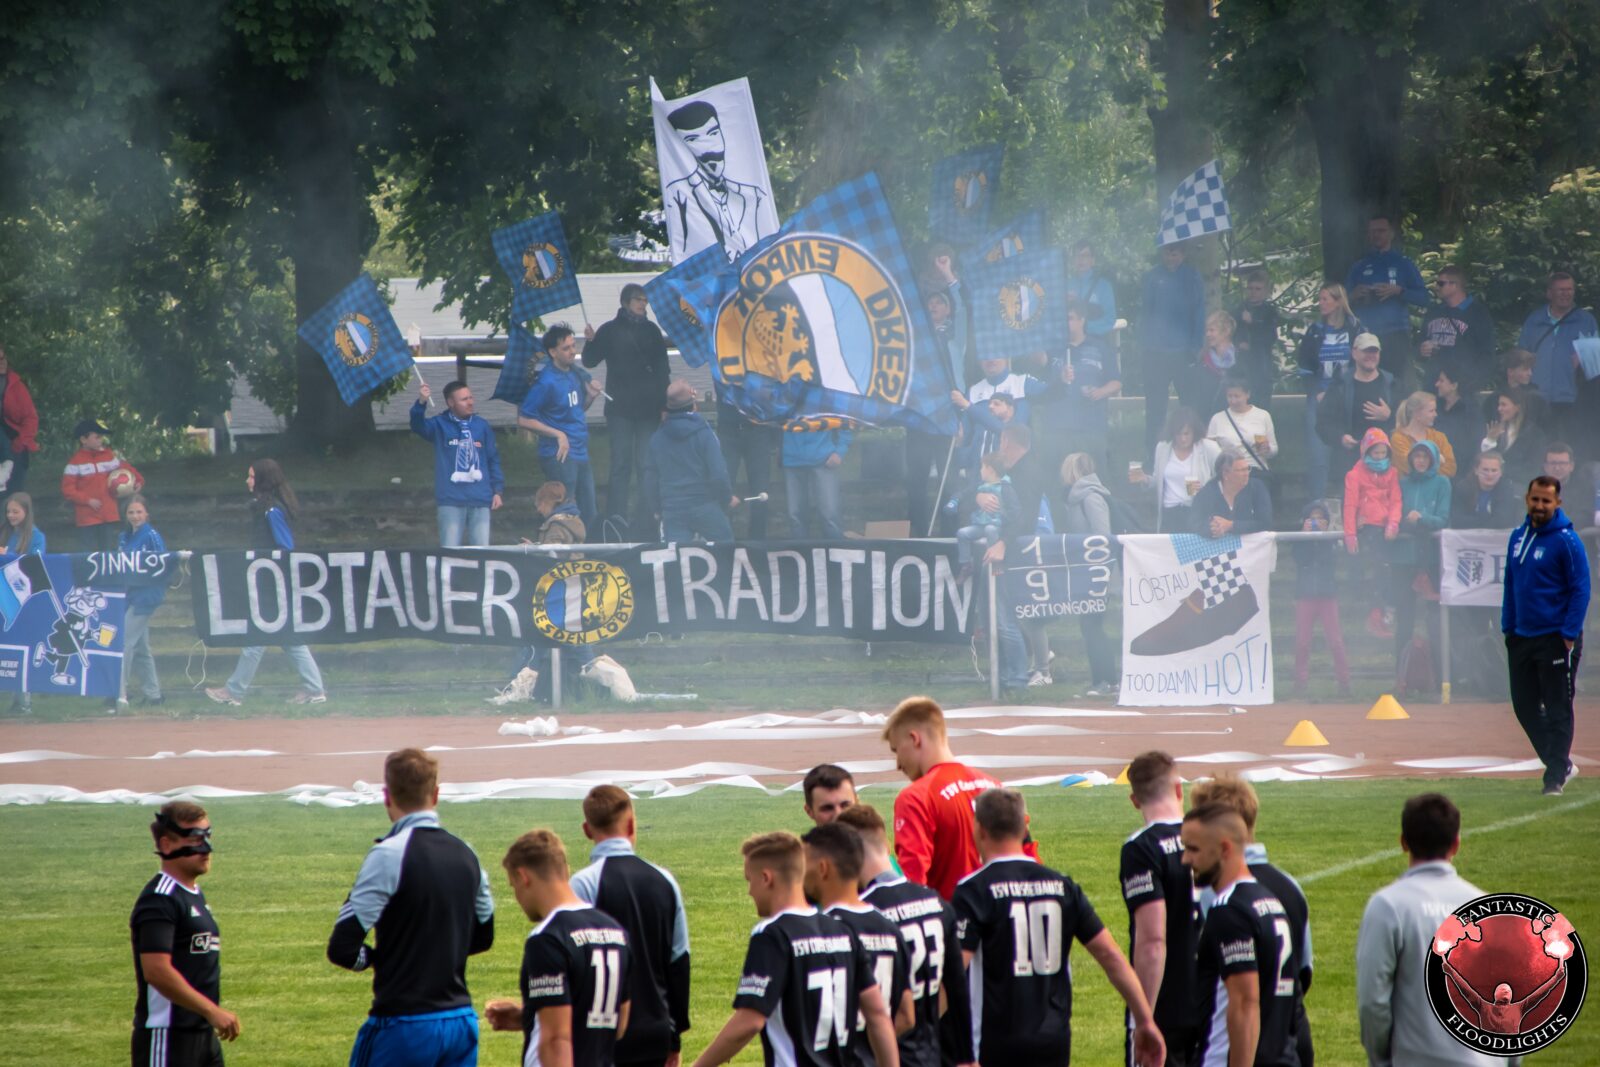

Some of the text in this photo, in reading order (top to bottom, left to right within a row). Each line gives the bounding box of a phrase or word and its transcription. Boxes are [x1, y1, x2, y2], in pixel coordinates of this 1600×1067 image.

[567, 390, 578, 408] 10
[86, 550, 171, 582] SINNLOS
[550, 562, 607, 580] EMPOR
[1021, 534, 1111, 565] 1 8
[202, 550, 522, 638] LÖBTAUER
[597, 575, 633, 640] LÖBTAU
[639, 545, 973, 634] TRADITION
[1025, 565, 1111, 601] 9 3
[1125, 633, 1268, 697] TOO DAMN HOT!
[940, 782, 960, 801] TSV
[990, 881, 1009, 899] TSV
[899, 917, 945, 1000] 23
[1009, 900, 1062, 977] 10
[1274, 918, 1295, 996] 2
[586, 949, 620, 1029] 11
